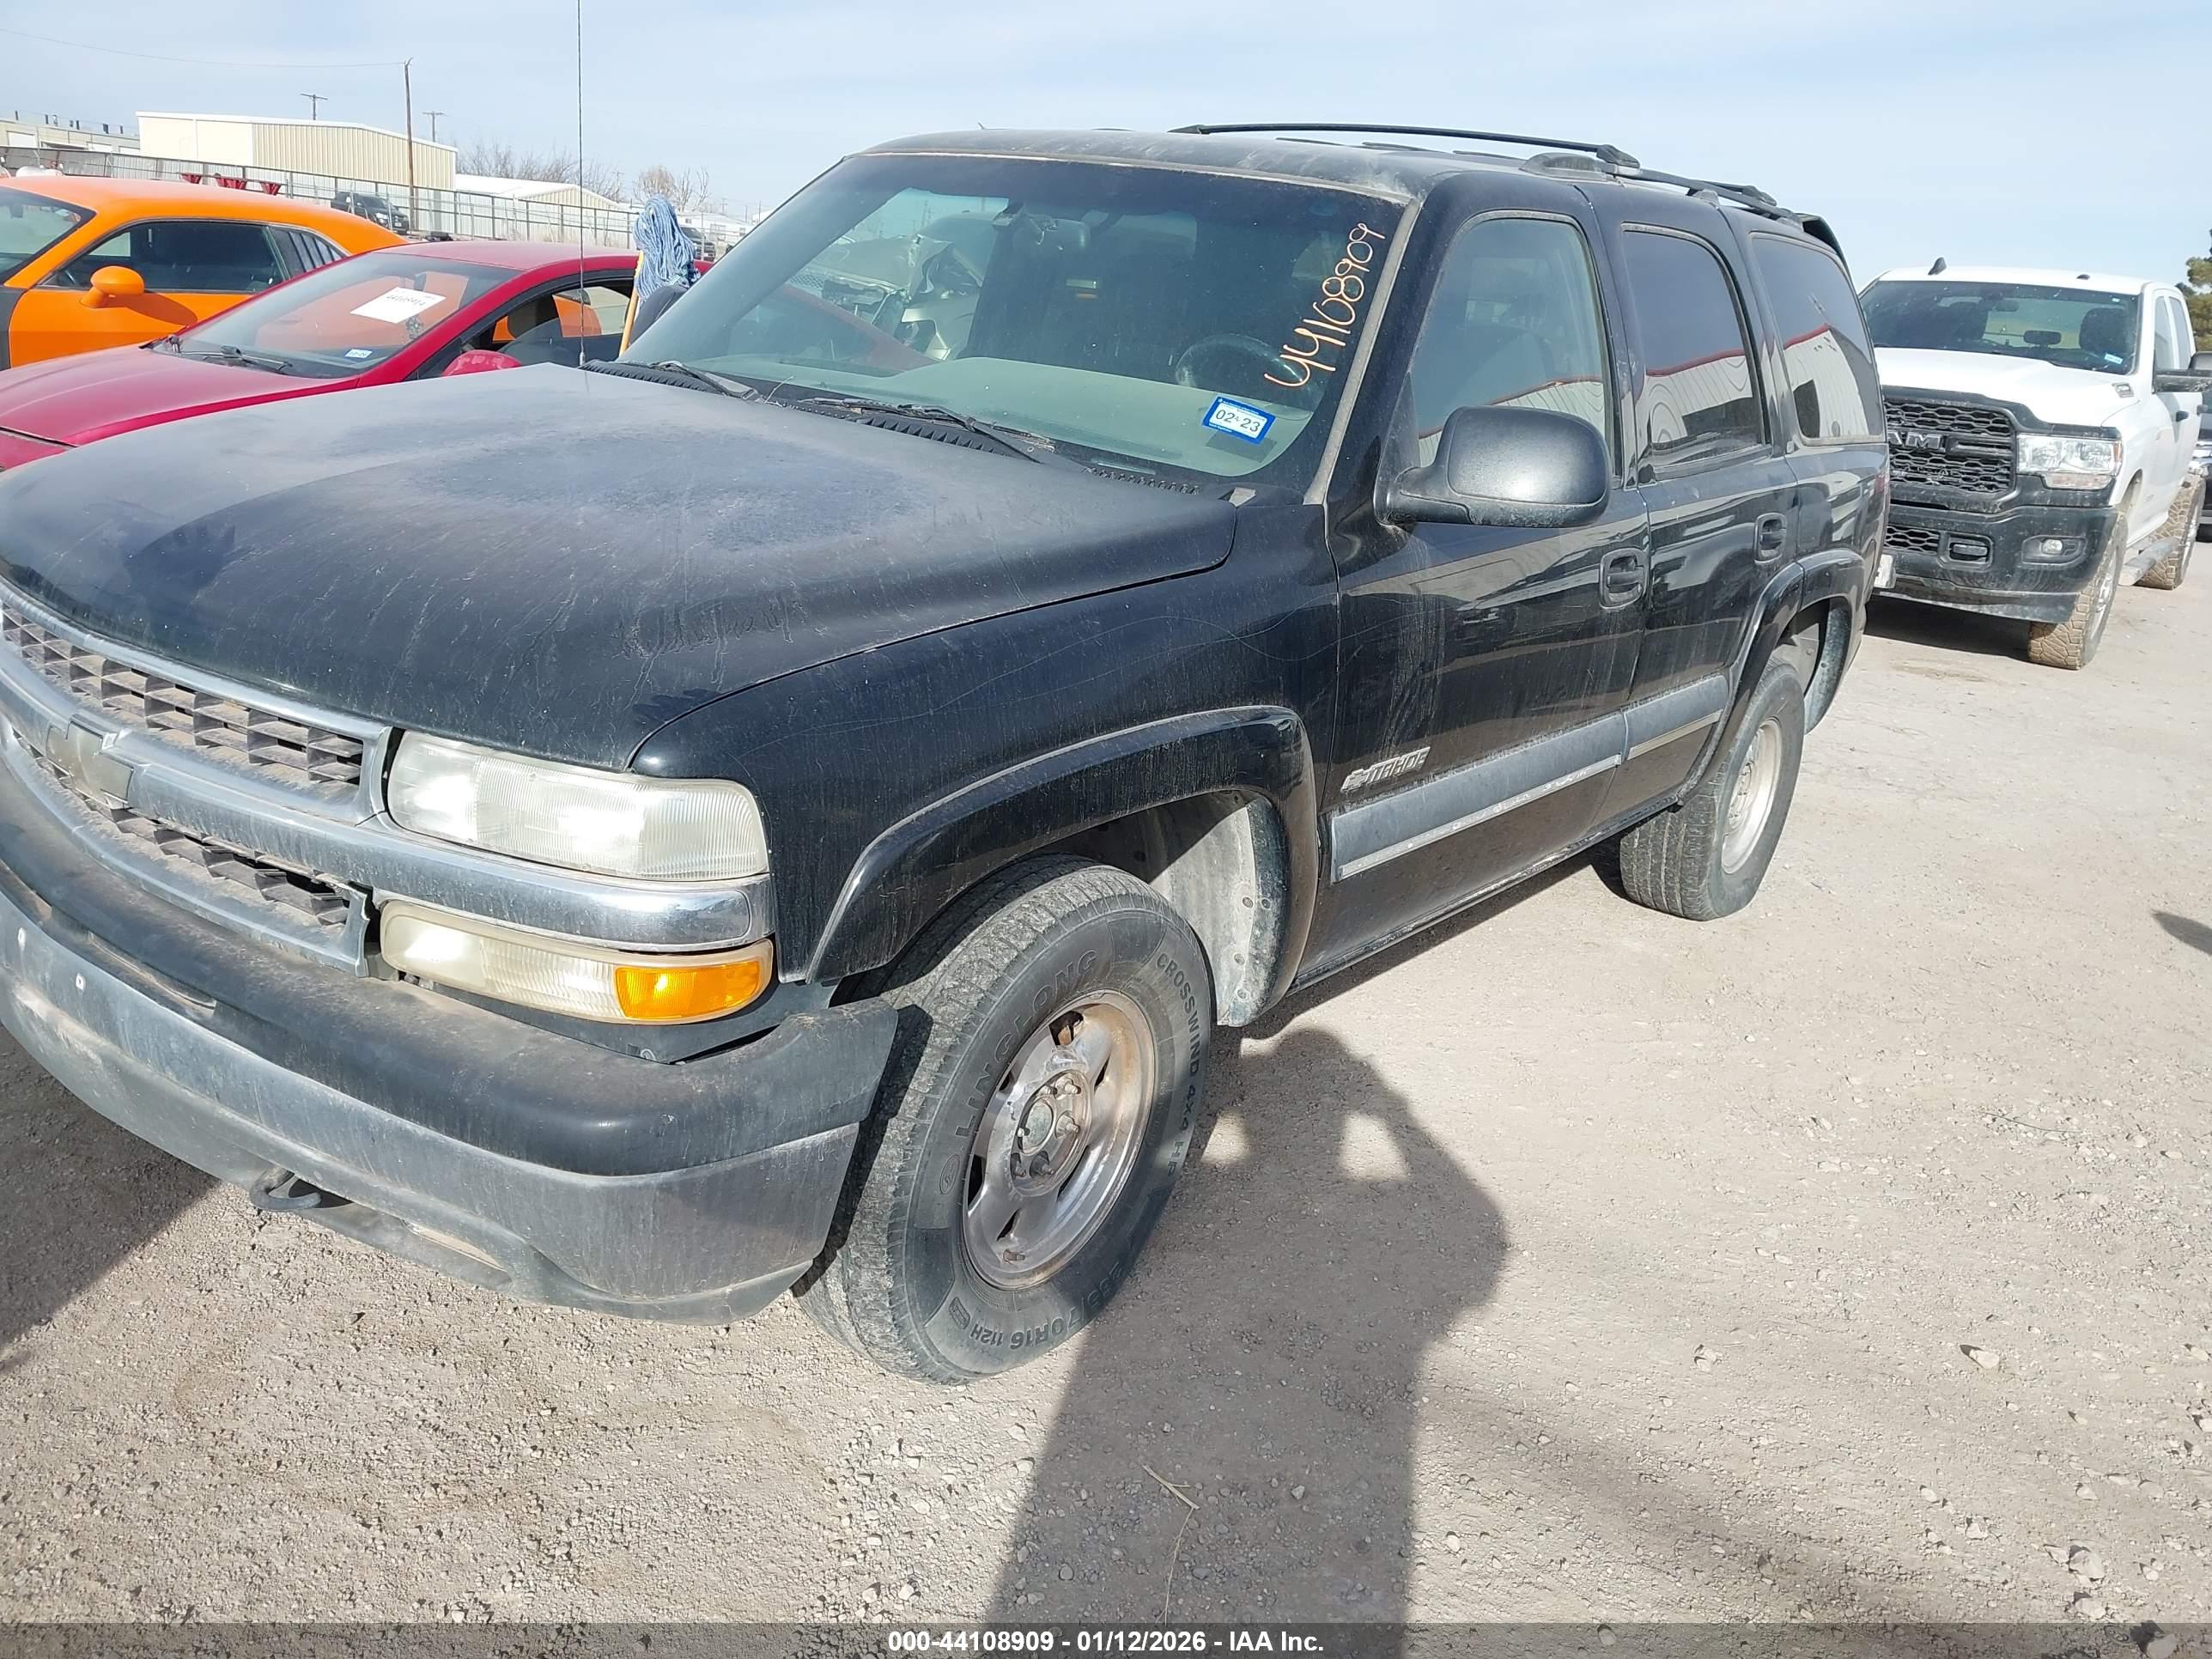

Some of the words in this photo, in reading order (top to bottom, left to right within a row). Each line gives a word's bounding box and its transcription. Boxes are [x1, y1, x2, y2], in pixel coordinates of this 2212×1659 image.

[1264, 222, 1386, 386] 44108909
[1215, 409, 1236, 423] 02
[1240, 417, 1261, 432] 23
[955, 949, 1098, 1138] LINGLONG
[1156, 952, 1200, 1077] CROSSWIND
[969, 1323, 1005, 1347] 112H
